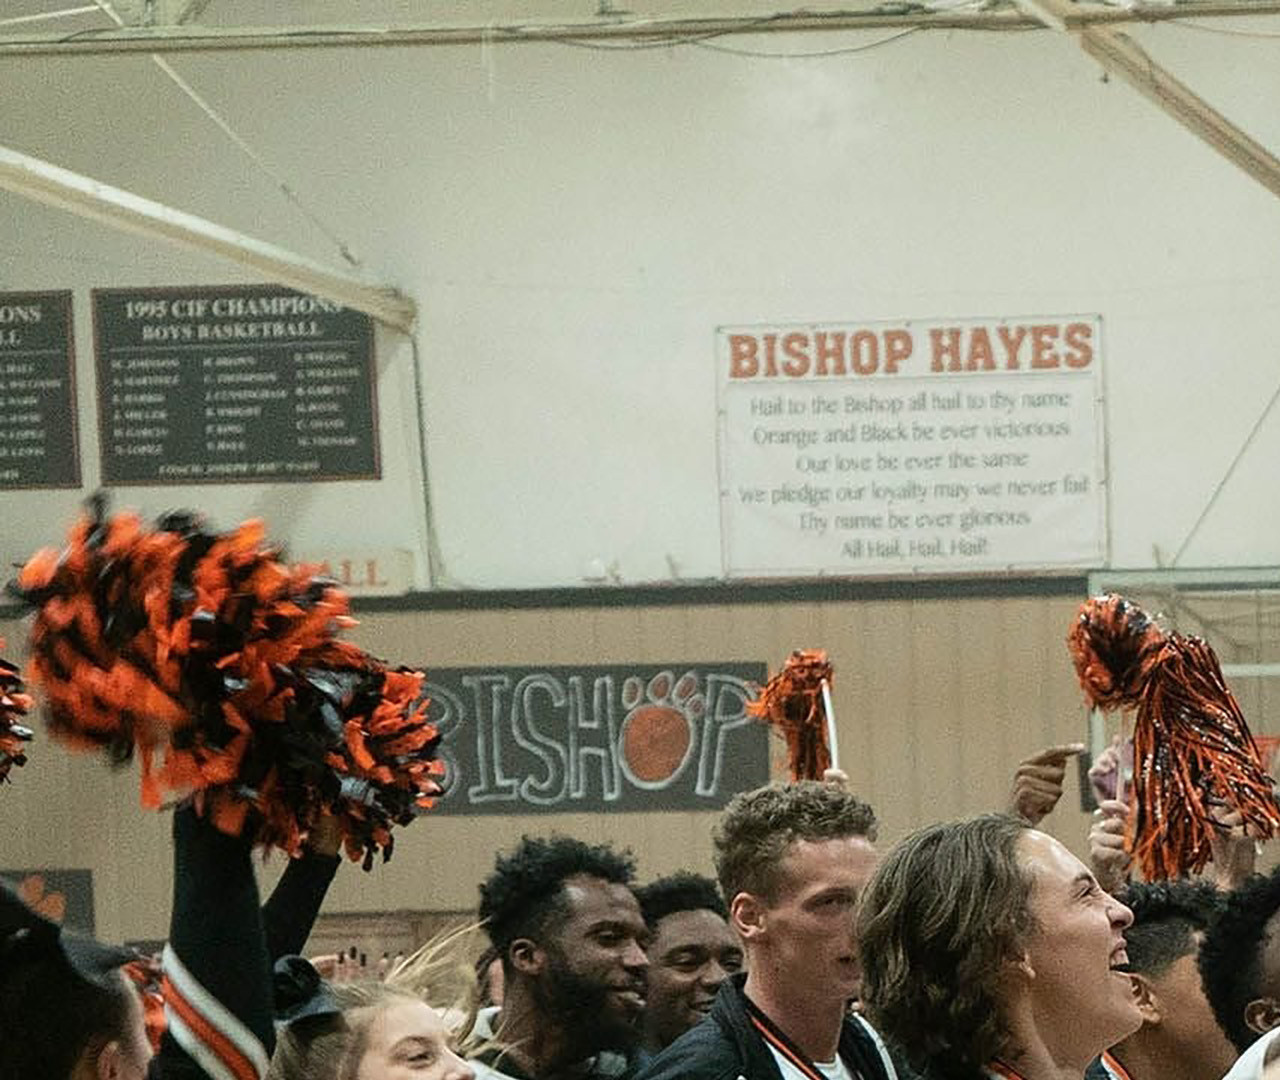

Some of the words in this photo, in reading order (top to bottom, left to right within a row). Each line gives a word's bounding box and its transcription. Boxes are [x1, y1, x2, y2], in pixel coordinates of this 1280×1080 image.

[127, 300, 168, 319] 1995
[172, 299, 209, 318] CIF
[143, 325, 193, 341] BOYS
[198, 321, 320, 339] BASKETBALL
[729, 329, 914, 379] BISHOP
[929, 323, 1093, 373] HAYES
[750, 395, 782, 416] Hail
[788, 395, 805, 415] to
[812, 394, 837, 414] the
[844, 392, 903, 415] Bishop
[909, 391, 926, 411] all
[932, 390, 960, 410] hail
[966, 392, 985, 409] to
[989, 389, 1016, 414] thy
[1022, 392, 1071, 408] name
[753, 427, 819, 449] Orange
[823, 422, 855, 443] and
[860, 422, 907, 442] Black
[912, 421, 934, 440] be
[940, 424, 978, 440] ever
[984, 419, 1071, 439] victorious
[796, 455, 829, 473] Our
[836, 453, 872, 471] love
[877, 451, 899, 470] be
[904, 455, 943, 470] ever
[948, 449, 976, 469] the
[983, 452, 1030, 468] same
[771, 482, 831, 507] pledge
[836, 485, 865, 502] our
[872, 479, 927, 504] loyalty
[933, 483, 969, 503] may
[976, 482, 1002, 497] we
[1008, 479, 1057, 496] never
[1063, 473, 1089, 494] fail
[800, 511, 828, 536] Thy
[834, 515, 882, 530] name
[887, 511, 909, 530] be
[915, 513, 953, 529] ever
[960, 508, 1032, 533] glorious
[842, 539, 864, 560] All
